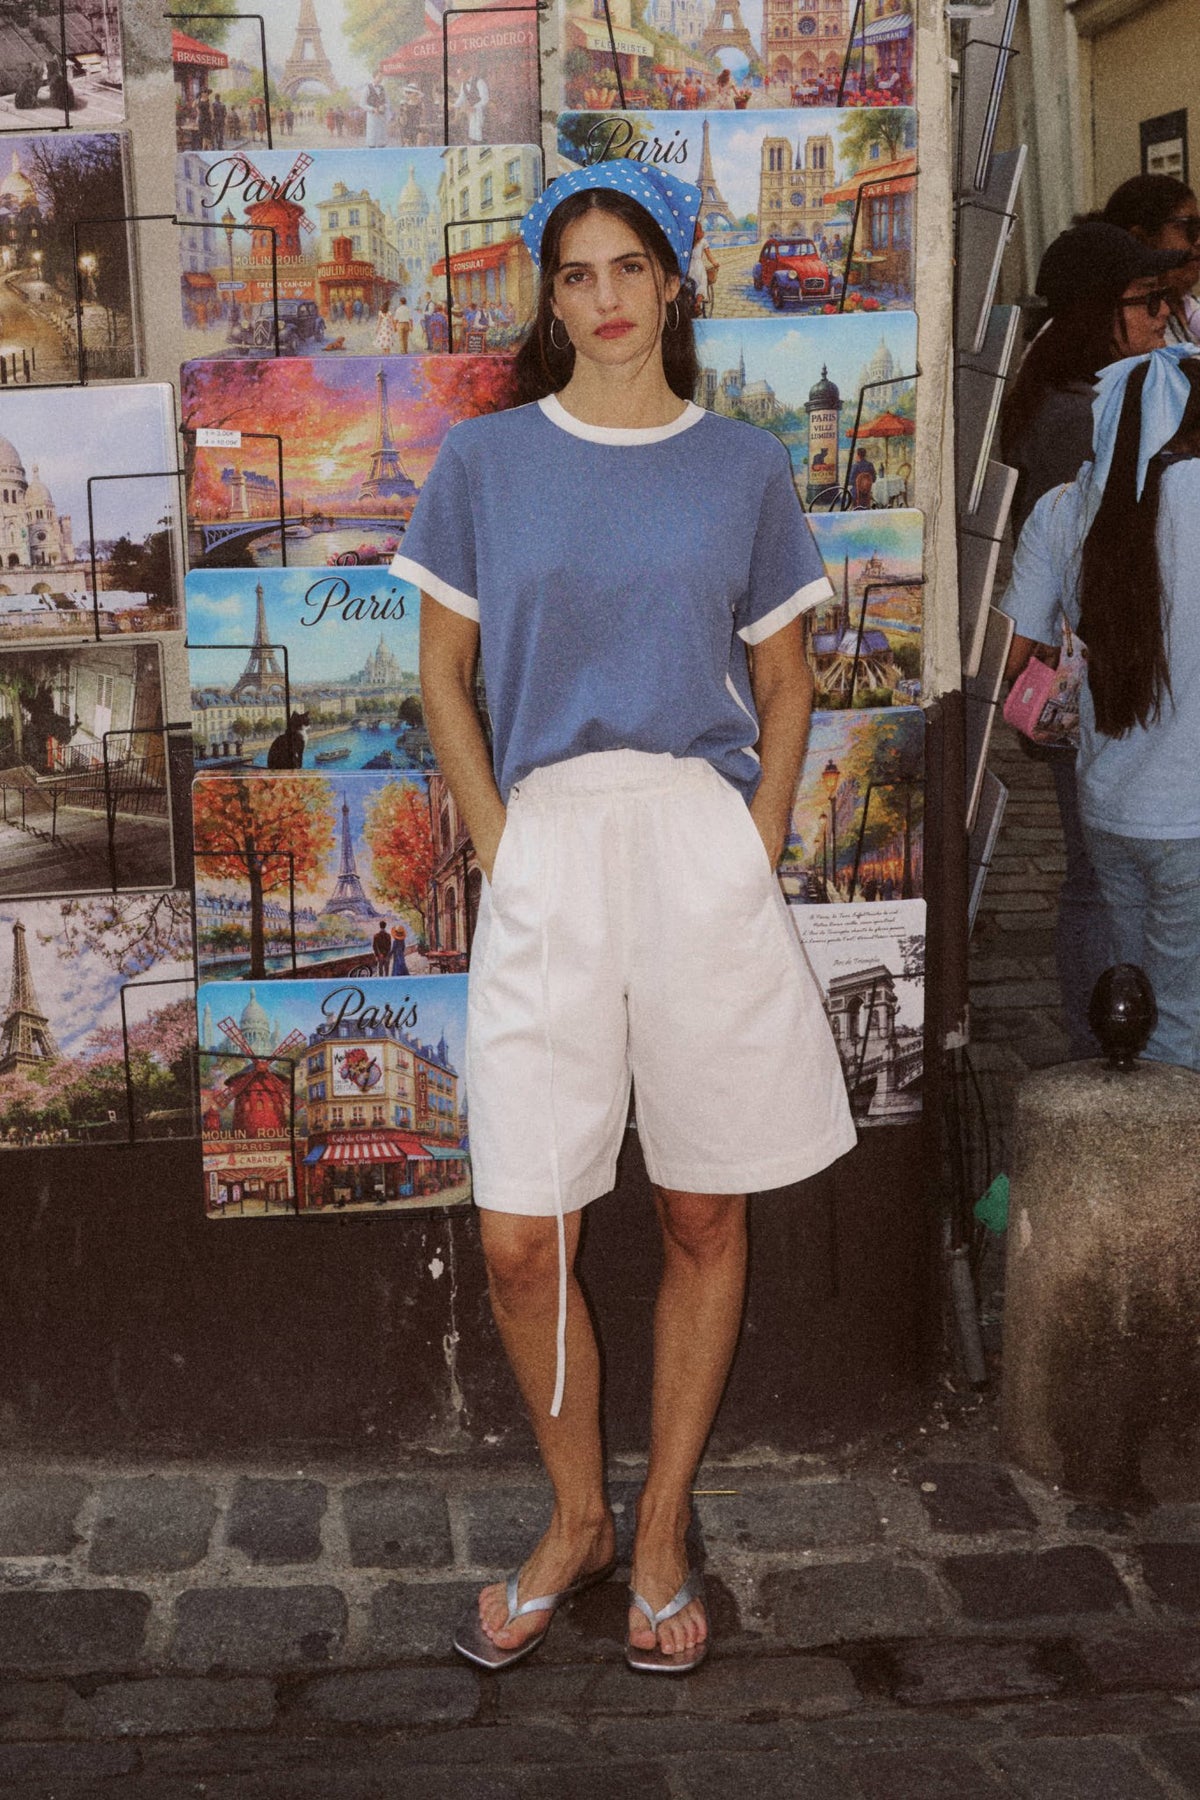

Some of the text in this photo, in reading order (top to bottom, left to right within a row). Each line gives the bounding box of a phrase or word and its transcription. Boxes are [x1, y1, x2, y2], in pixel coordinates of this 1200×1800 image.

[463, 31, 526, 50] TROCADERO
[176, 50, 226, 67] BRASSERIE
[582, 117, 689, 165] Paris
[201, 157, 306, 209] Paris
[233, 254, 272, 266] MOULIN
[453, 259, 485, 272] CONSULAT
[317, 265, 375, 278] MOULIN ROUGE
[256, 281, 283, 289] FRENH
[811, 413, 836, 423] PARIS
[814, 424, 833, 432] VILLE
[300, 576, 405, 627] Paris
[317, 985, 418, 1036] Paris
[419, 1074, 427, 1117] HOTEL
[201, 1128, 247, 1140] MOULIN
[234, 1142, 272, 1151] PARIS
[240, 1155, 278, 1164] CABARET
